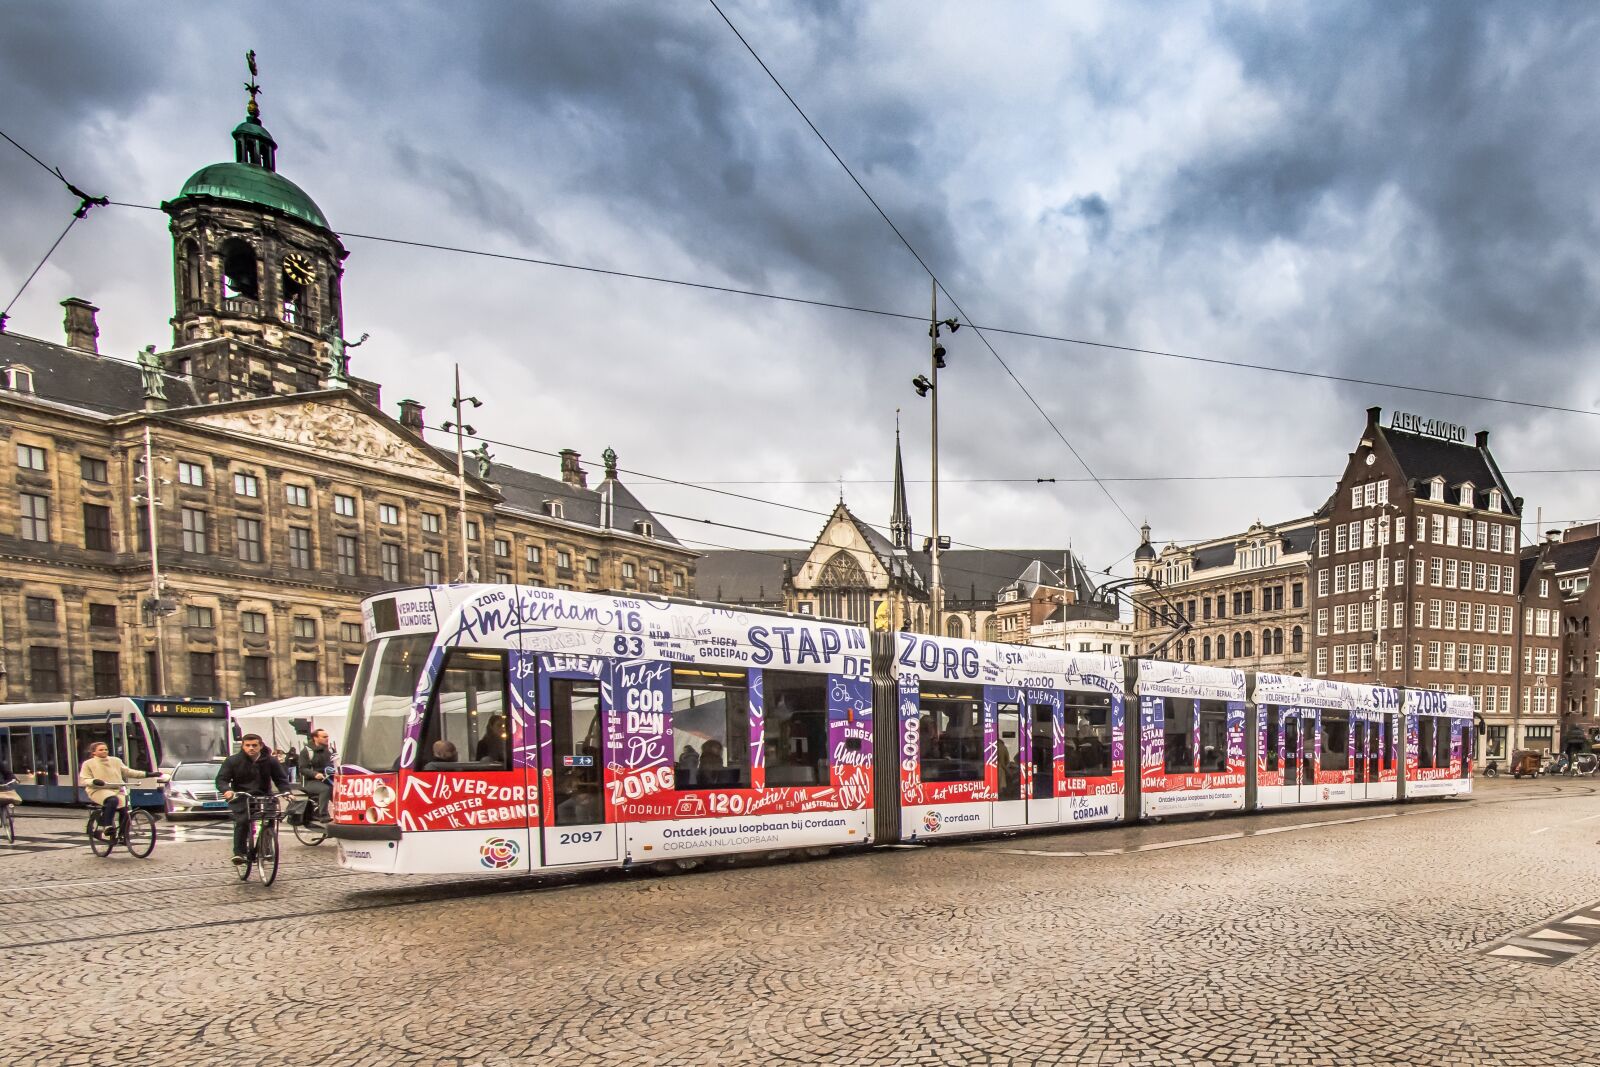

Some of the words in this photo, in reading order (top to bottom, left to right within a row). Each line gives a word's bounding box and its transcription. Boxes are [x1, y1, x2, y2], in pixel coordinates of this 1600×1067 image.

[398, 601, 434, 614] VERPLEEG
[476, 591, 506, 607] ZORG
[526, 589, 554, 600] VOOR
[613, 599, 641, 609] SINDS
[400, 614, 432, 626] KUNDIGE
[444, 595, 613, 647] Amsterdam
[614, 609, 642, 632] 16
[613, 634, 644, 656] 83
[712, 637, 737, 647] EIGEN
[747, 625, 841, 664] STAP
[844, 628, 866, 649] IN
[700, 647, 748, 661] GROEIPAD
[898, 633, 979, 680] ZORG
[541, 654, 604, 680] LEREN
[615, 663, 671, 690] helpt
[842, 655, 871, 681] DE
[1023, 676, 1054, 688] 20.000
[626, 688, 664, 712] COR
[1371, 688, 1399, 709] STAP
[1415, 691, 1447, 714] ZORG
[1301, 708, 1316, 719] STAD
[625, 735, 668, 770] De
[833, 741, 873, 770] anders
[831, 759, 846, 776] te
[433, 773, 452, 800] Ik
[452, 777, 538, 801] VERZORG
[605, 766, 675, 806] ZORG
[933, 787, 948, 800] het
[947, 781, 986, 795] VERSCHIL
[1058, 780, 1067, 792] IK
[1067, 778, 1087, 790] LEER
[1095, 782, 1118, 796] GROEI
[1185, 776, 1193, 787] IK
[1213, 773, 1237, 787] KANTEN
[424, 797, 483, 822] VERBETER
[621, 804, 673, 816] VOORUIT
[708, 792, 745, 815] 120
[801, 800, 839, 812] AMSTERDAM
[1073, 805, 1109, 820] CORDAAN
[447, 813, 465, 829] Ik
[464, 803, 539, 826] VERBIND
[944, 813, 980, 823] cordaan
[560, 831, 603, 845] 2097
[662, 826, 707, 839] Ontdek
[708, 825, 737, 837] jouw
[739, 822, 790, 834] loopbaan
[791, 820, 803, 830] bij
[804, 817, 847, 829] Cordaan
[662, 835, 779, 851] CORDAAN.NL/LOOPBAAN
